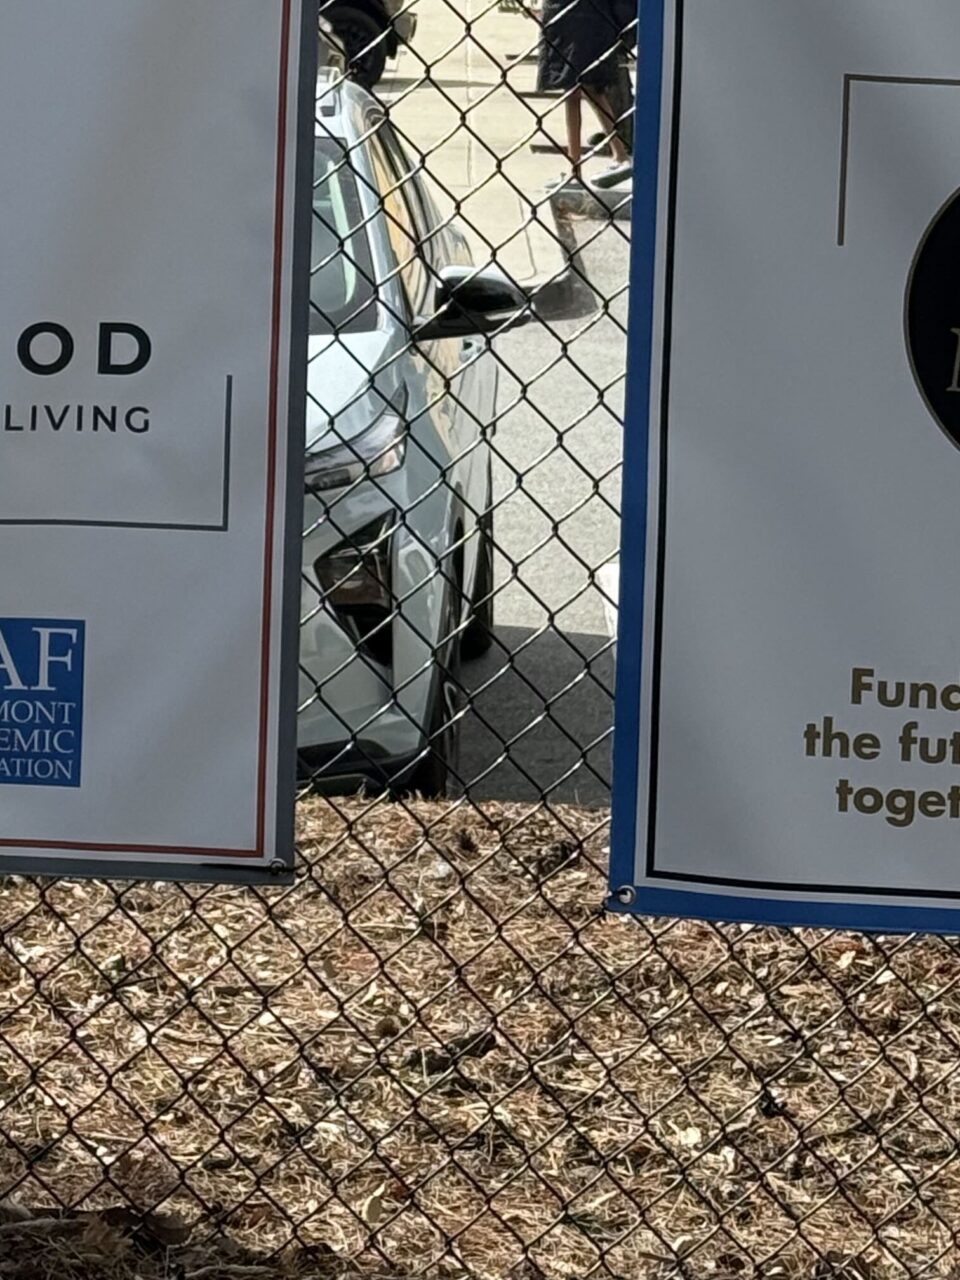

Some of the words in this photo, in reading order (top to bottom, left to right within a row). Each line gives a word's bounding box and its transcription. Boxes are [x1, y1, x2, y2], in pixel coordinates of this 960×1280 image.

[4, 404, 151, 434] LIVING
[803, 715, 881, 761] the
[835, 778, 960, 828] toget
